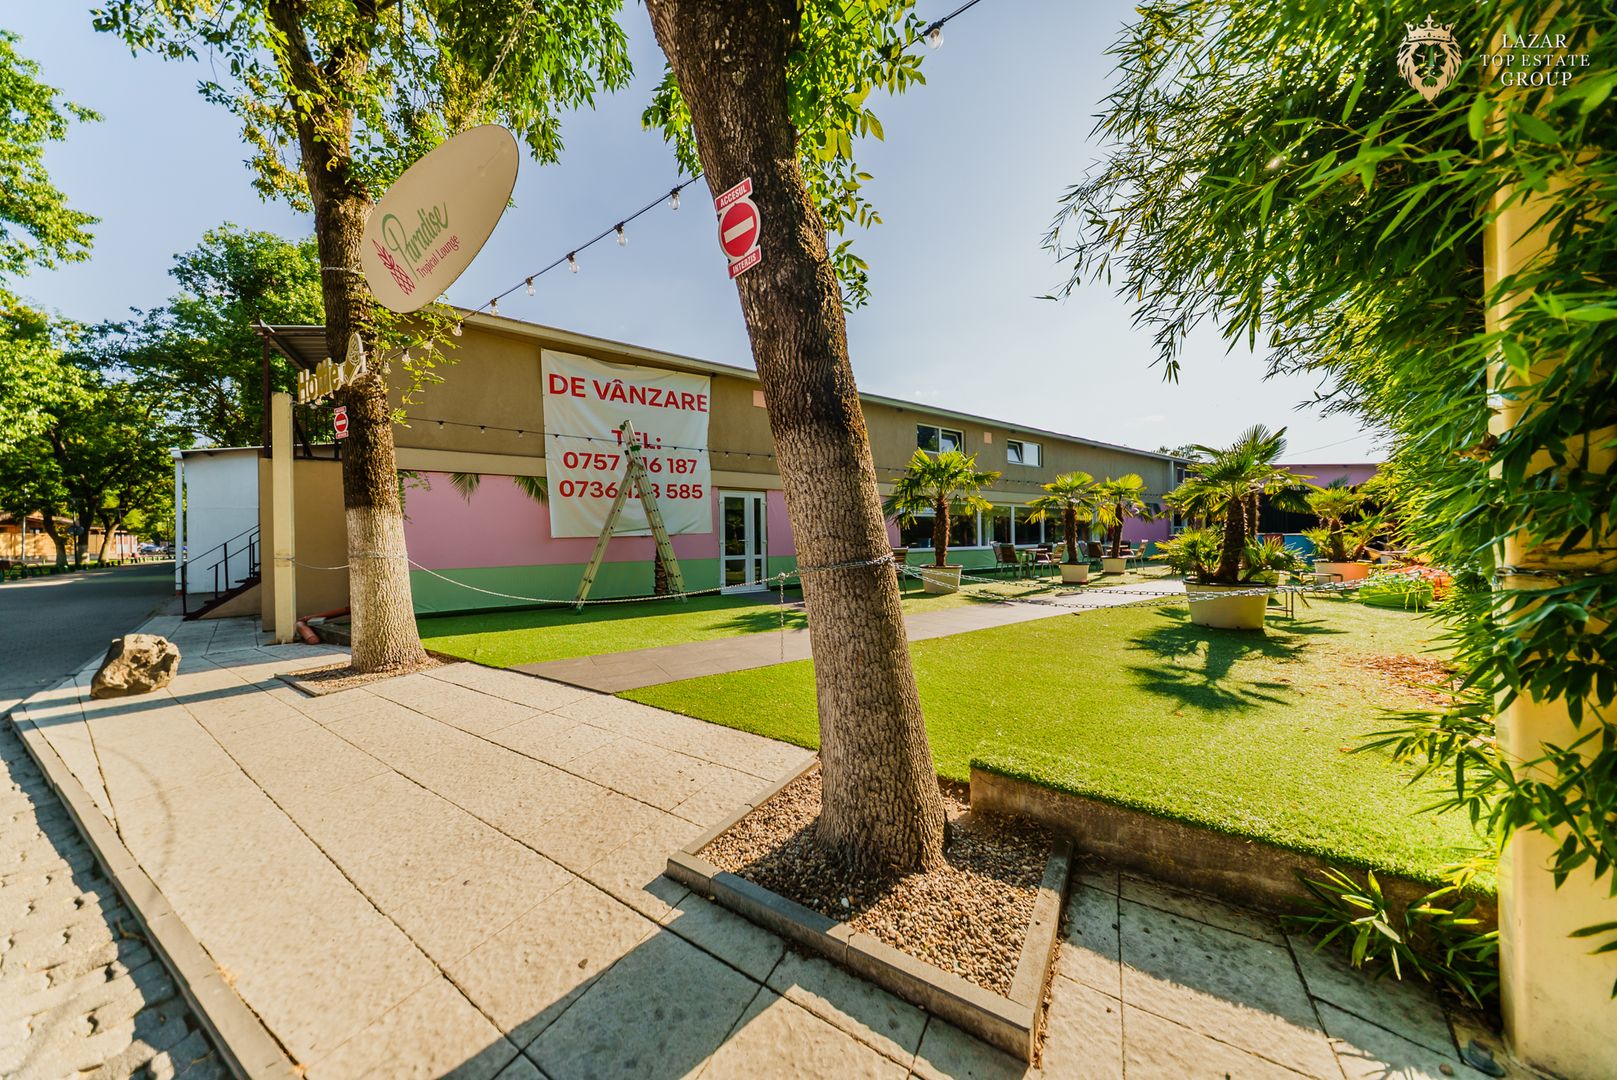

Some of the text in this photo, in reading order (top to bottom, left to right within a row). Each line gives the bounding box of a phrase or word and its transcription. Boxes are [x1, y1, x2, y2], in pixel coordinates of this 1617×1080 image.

[720, 184, 747, 208] ACCESUL
[381, 201, 449, 281] Paradise
[415, 234, 460, 278] Tropical Lounge
[732, 253, 757, 274] INTERZIS
[548, 373, 708, 412] DE VÂNZARE
[562, 451, 620, 471] 0757
[666, 458, 698, 474] 187
[559, 480, 619, 498] 0736
[666, 484, 703, 499] 585
